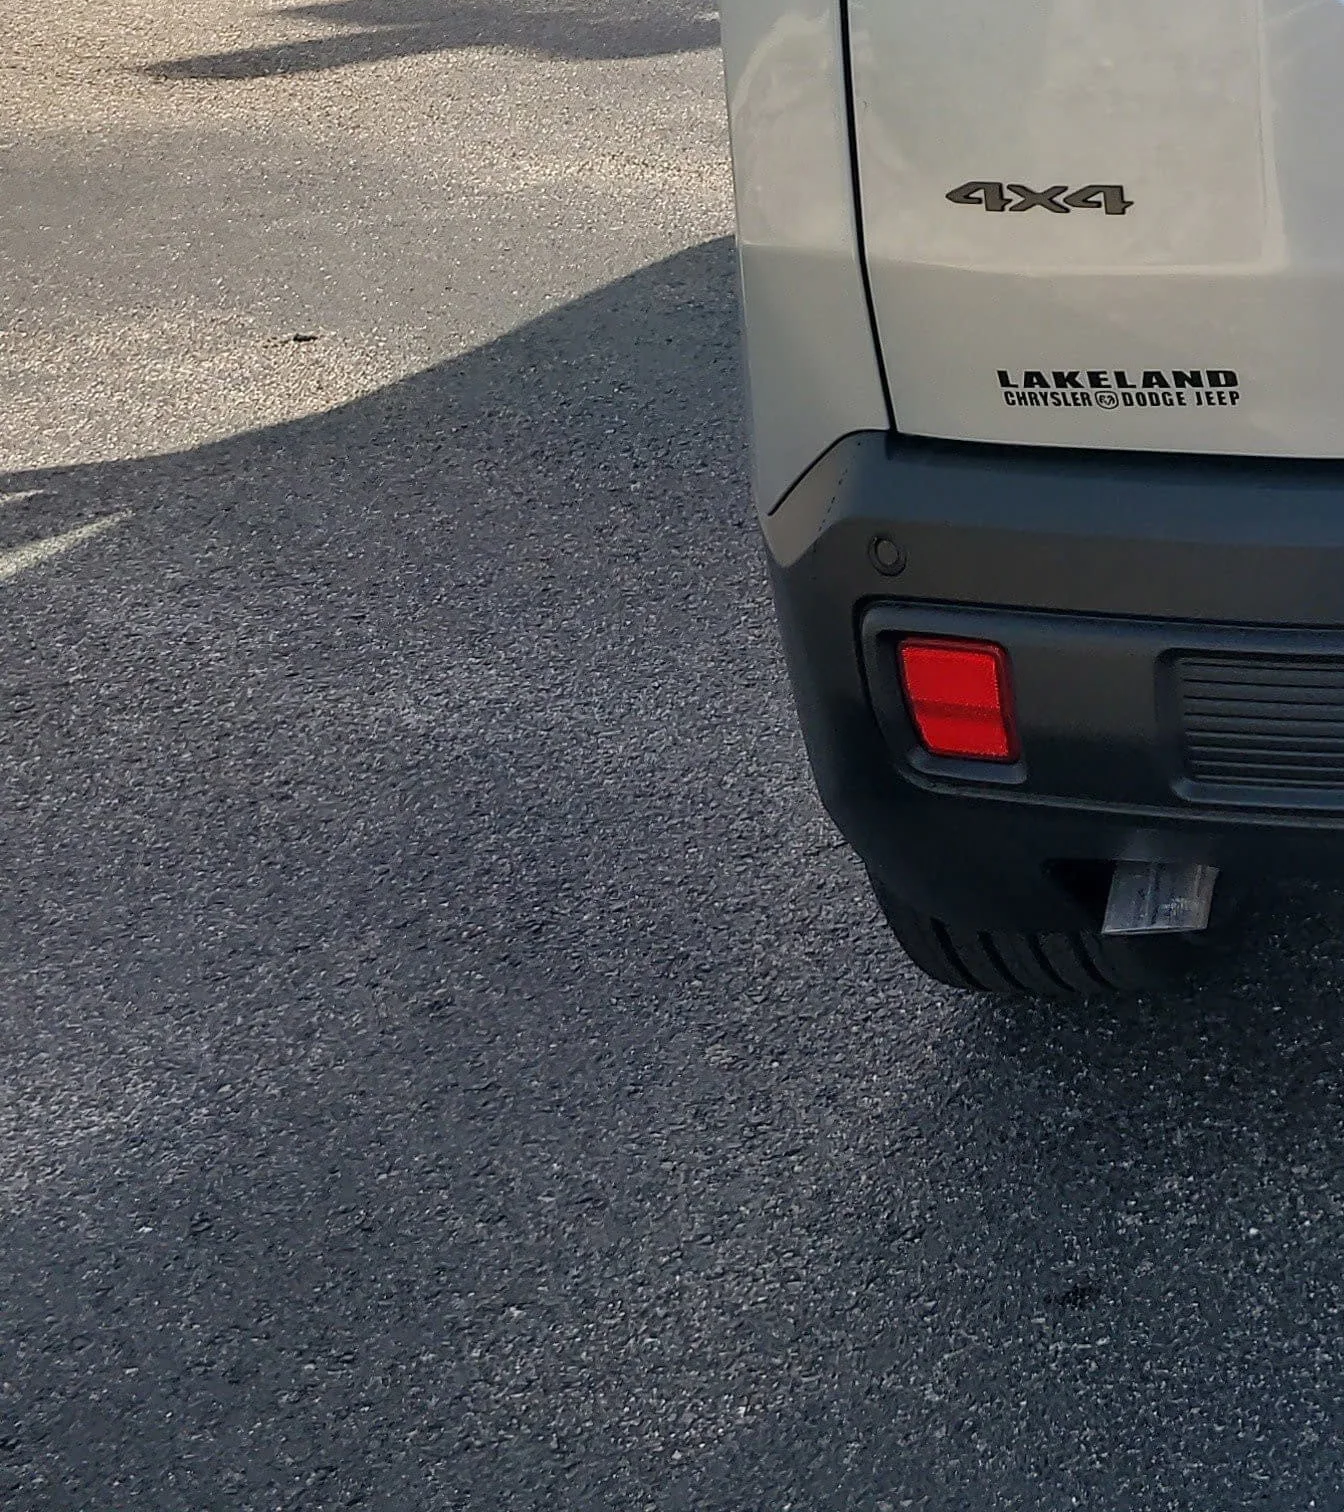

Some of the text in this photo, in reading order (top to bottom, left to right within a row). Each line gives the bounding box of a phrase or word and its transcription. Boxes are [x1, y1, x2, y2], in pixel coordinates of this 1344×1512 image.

[996, 369, 1240, 389] LAKELAND
[1003, 390, 1241, 407] CHRYSLER DODGE JEEP
